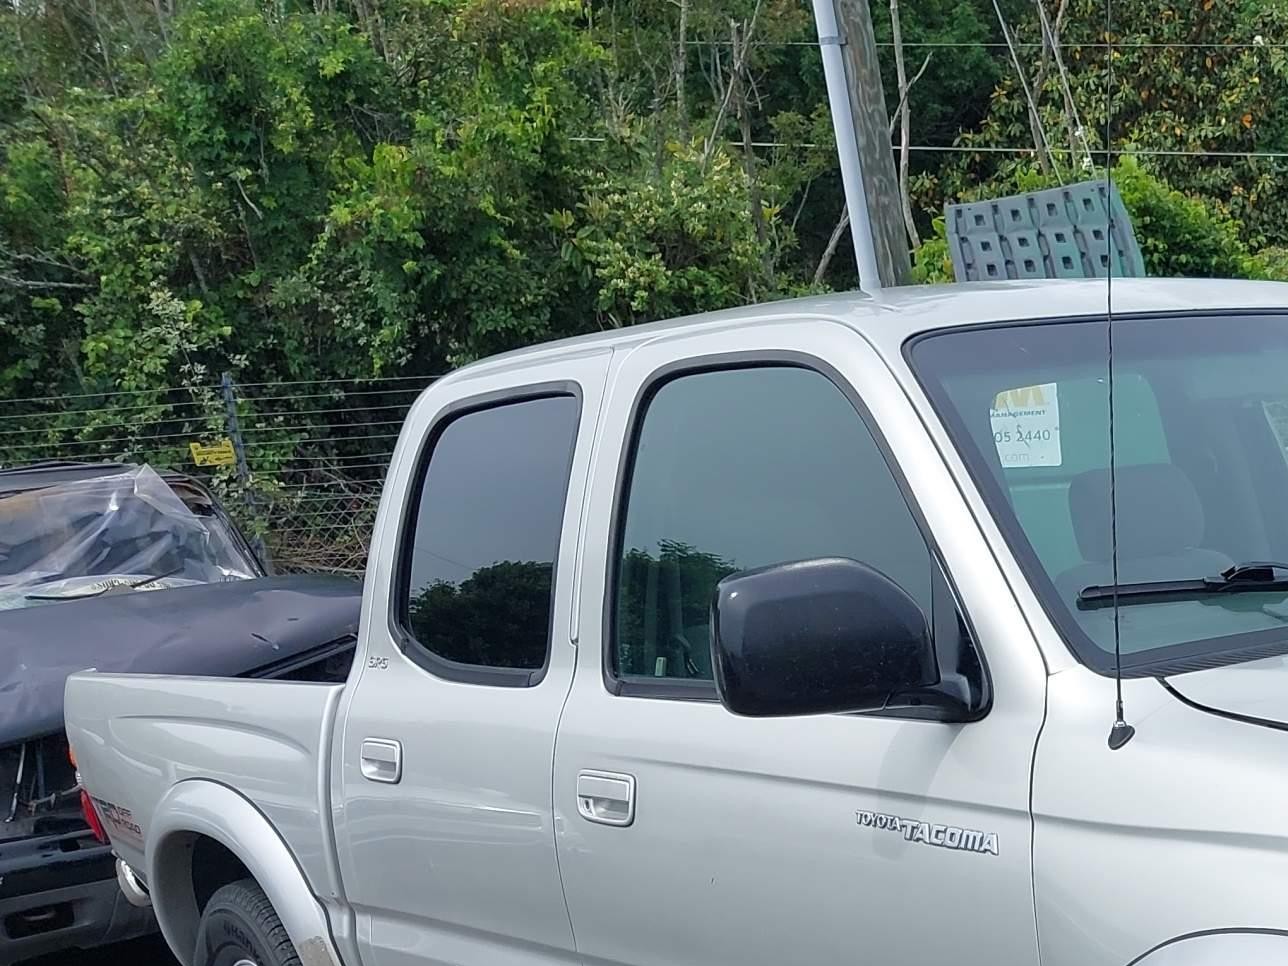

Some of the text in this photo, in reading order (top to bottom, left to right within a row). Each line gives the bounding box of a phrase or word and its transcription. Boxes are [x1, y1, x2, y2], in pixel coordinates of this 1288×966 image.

[368, 656, 389, 669] SR5
[855, 809, 999, 856] TOYOTA TACOMA
